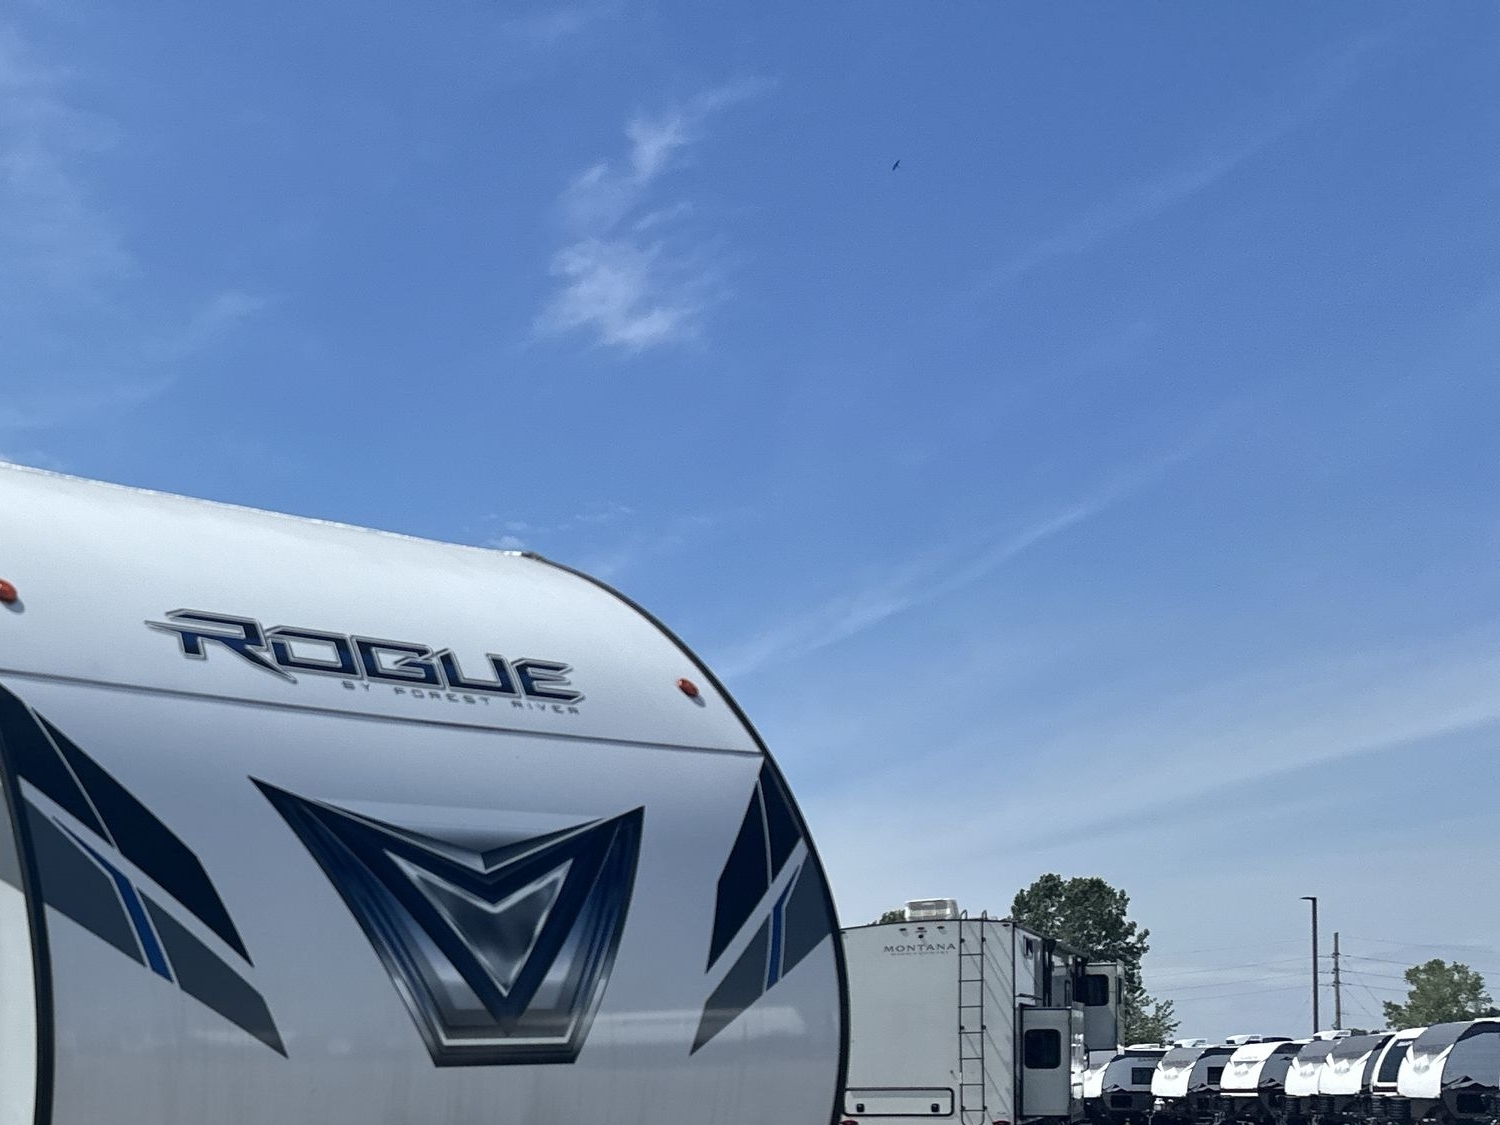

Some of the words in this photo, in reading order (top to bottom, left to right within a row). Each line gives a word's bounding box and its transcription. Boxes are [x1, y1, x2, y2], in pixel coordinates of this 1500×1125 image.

[145, 608, 587, 704] ROGUE
[342, 680, 371, 692] BY
[394, 686, 491, 706] FOREST
[511, 699, 581, 716] RIVER
[884, 943, 956, 953] MONTANA
